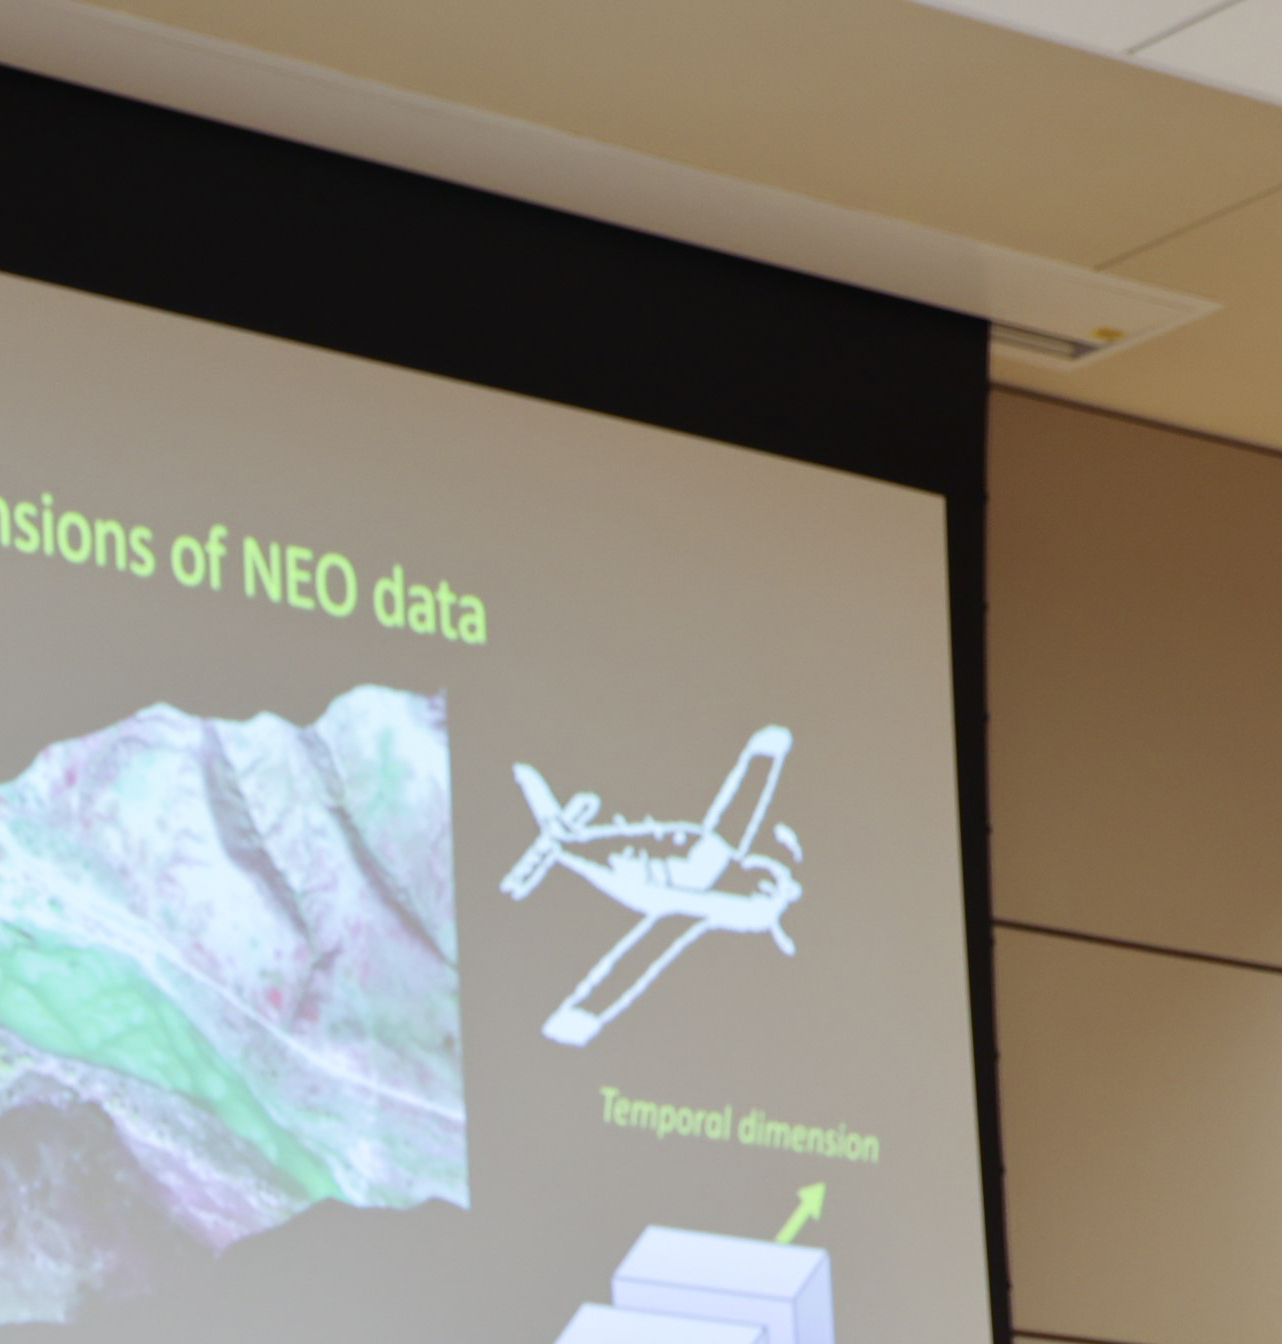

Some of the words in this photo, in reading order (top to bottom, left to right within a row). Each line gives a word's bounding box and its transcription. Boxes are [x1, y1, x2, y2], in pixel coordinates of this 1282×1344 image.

[171, 524, 228, 591] of
[243, 536, 357, 618] NEO
[373, 563, 487, 645] data
[600, 1085, 733, 1140] Temporal
[738, 1108, 880, 1163] dimension
